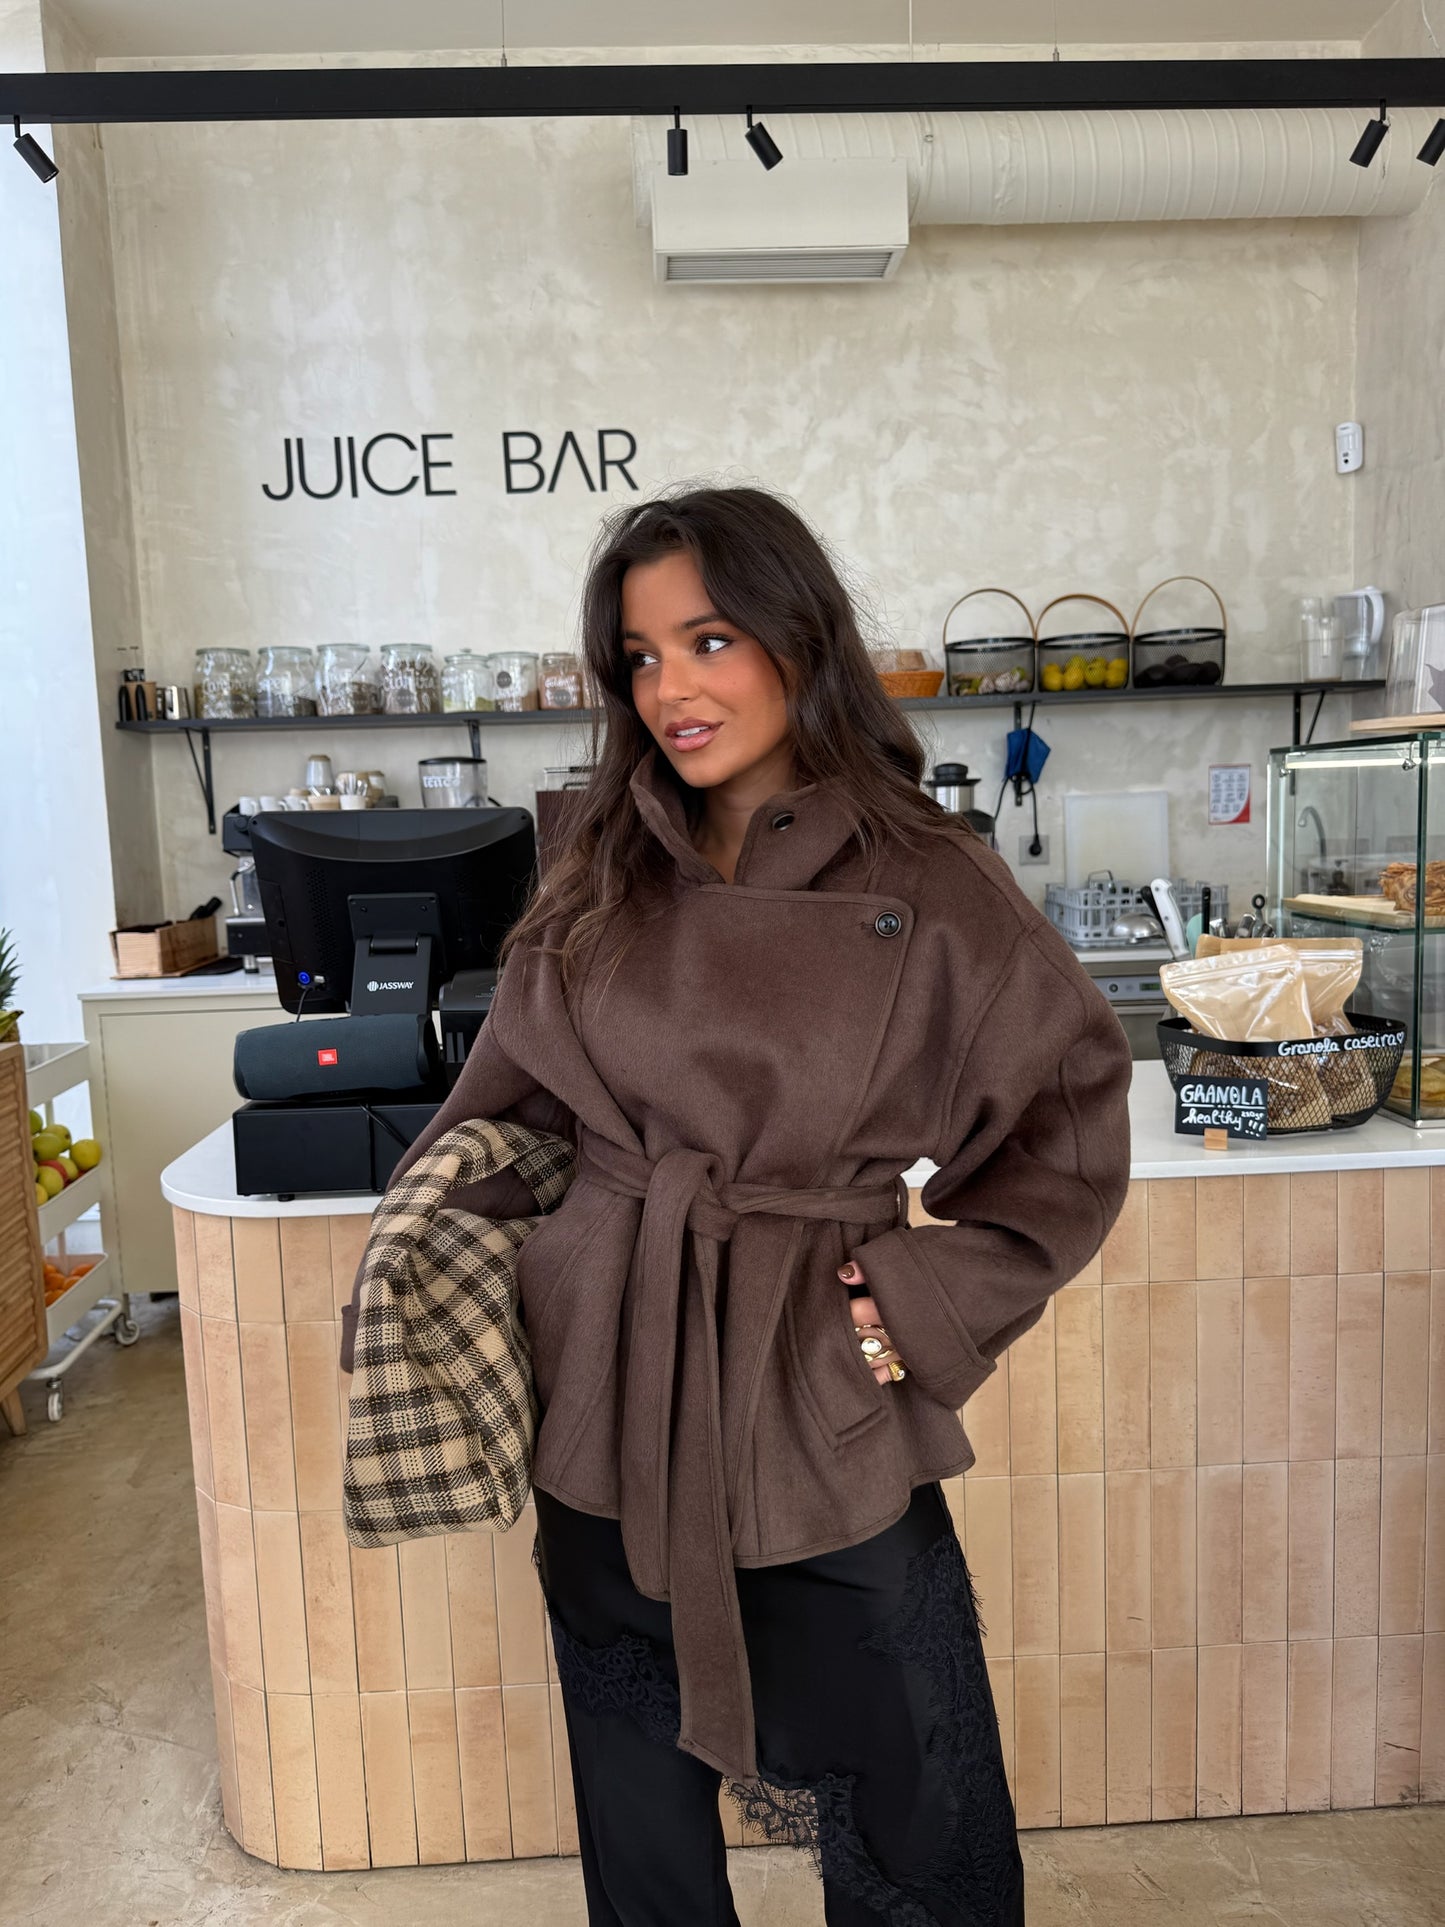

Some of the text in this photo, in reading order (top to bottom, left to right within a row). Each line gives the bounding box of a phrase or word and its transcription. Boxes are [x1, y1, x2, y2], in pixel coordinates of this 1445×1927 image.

[261, 429, 640, 501] JUICE BAR
[379, 981, 414, 990] JASSWAY
[1278, 1033, 1397, 1056] Granola caseira
[1180, 1084, 1263, 1105] GRANOLA
[1182, 1108, 1242, 1131] healthy
